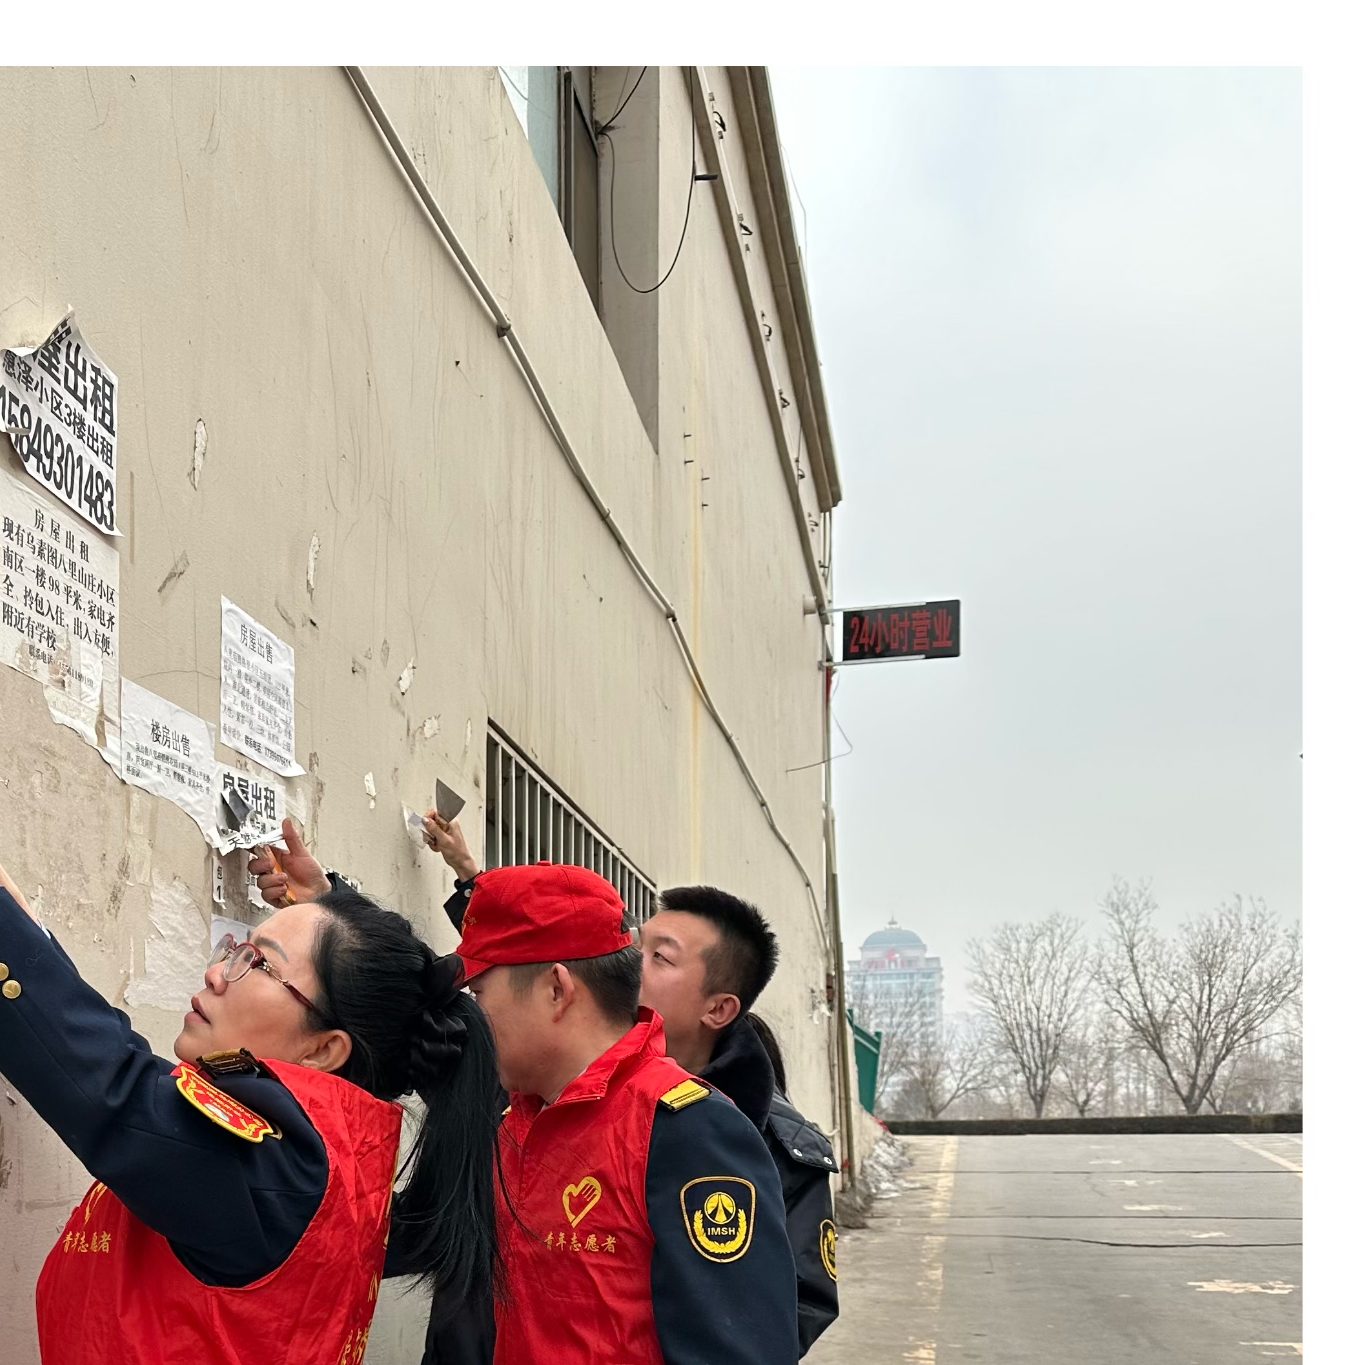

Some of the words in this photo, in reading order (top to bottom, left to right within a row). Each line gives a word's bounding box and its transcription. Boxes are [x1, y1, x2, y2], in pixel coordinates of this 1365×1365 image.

[35, 508, 90, 563] 房屋出租
[2, 516, 116, 607] 现有乌素图八里山庄小区
[2, 601, 57, 651] 附近有学校
[240, 623, 274, 665] 房屋出售
[848, 608, 953, 654] 24小时营业
[151, 718, 191, 758] 楼房出售
[544, 1230, 617, 1254] 青年志愿者
[707, 1226, 737, 1237] IMSH
